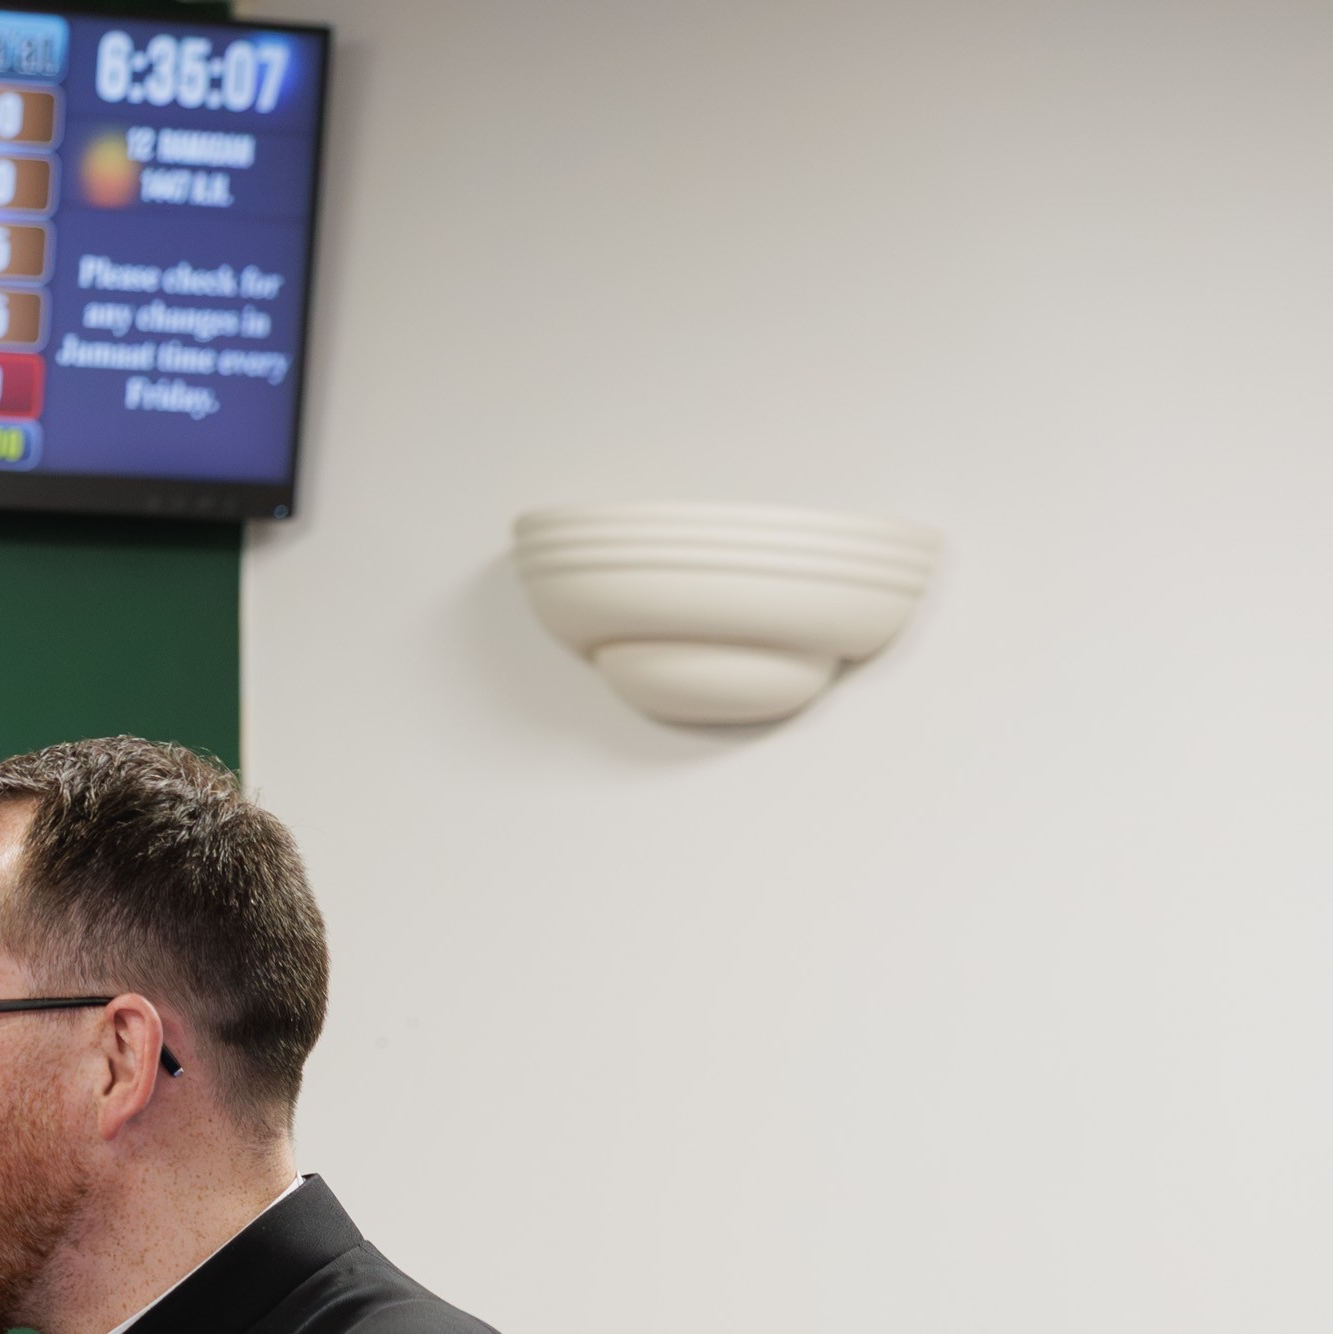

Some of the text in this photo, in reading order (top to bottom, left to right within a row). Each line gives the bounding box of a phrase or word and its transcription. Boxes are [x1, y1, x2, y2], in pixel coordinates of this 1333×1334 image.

[96, 30, 291, 113] 6:35:07
[78, 254, 285, 300] Please check for
[83, 299, 272, 342] any changes in
[157, 339, 217, 375] time
[217, 349, 292, 386] every
